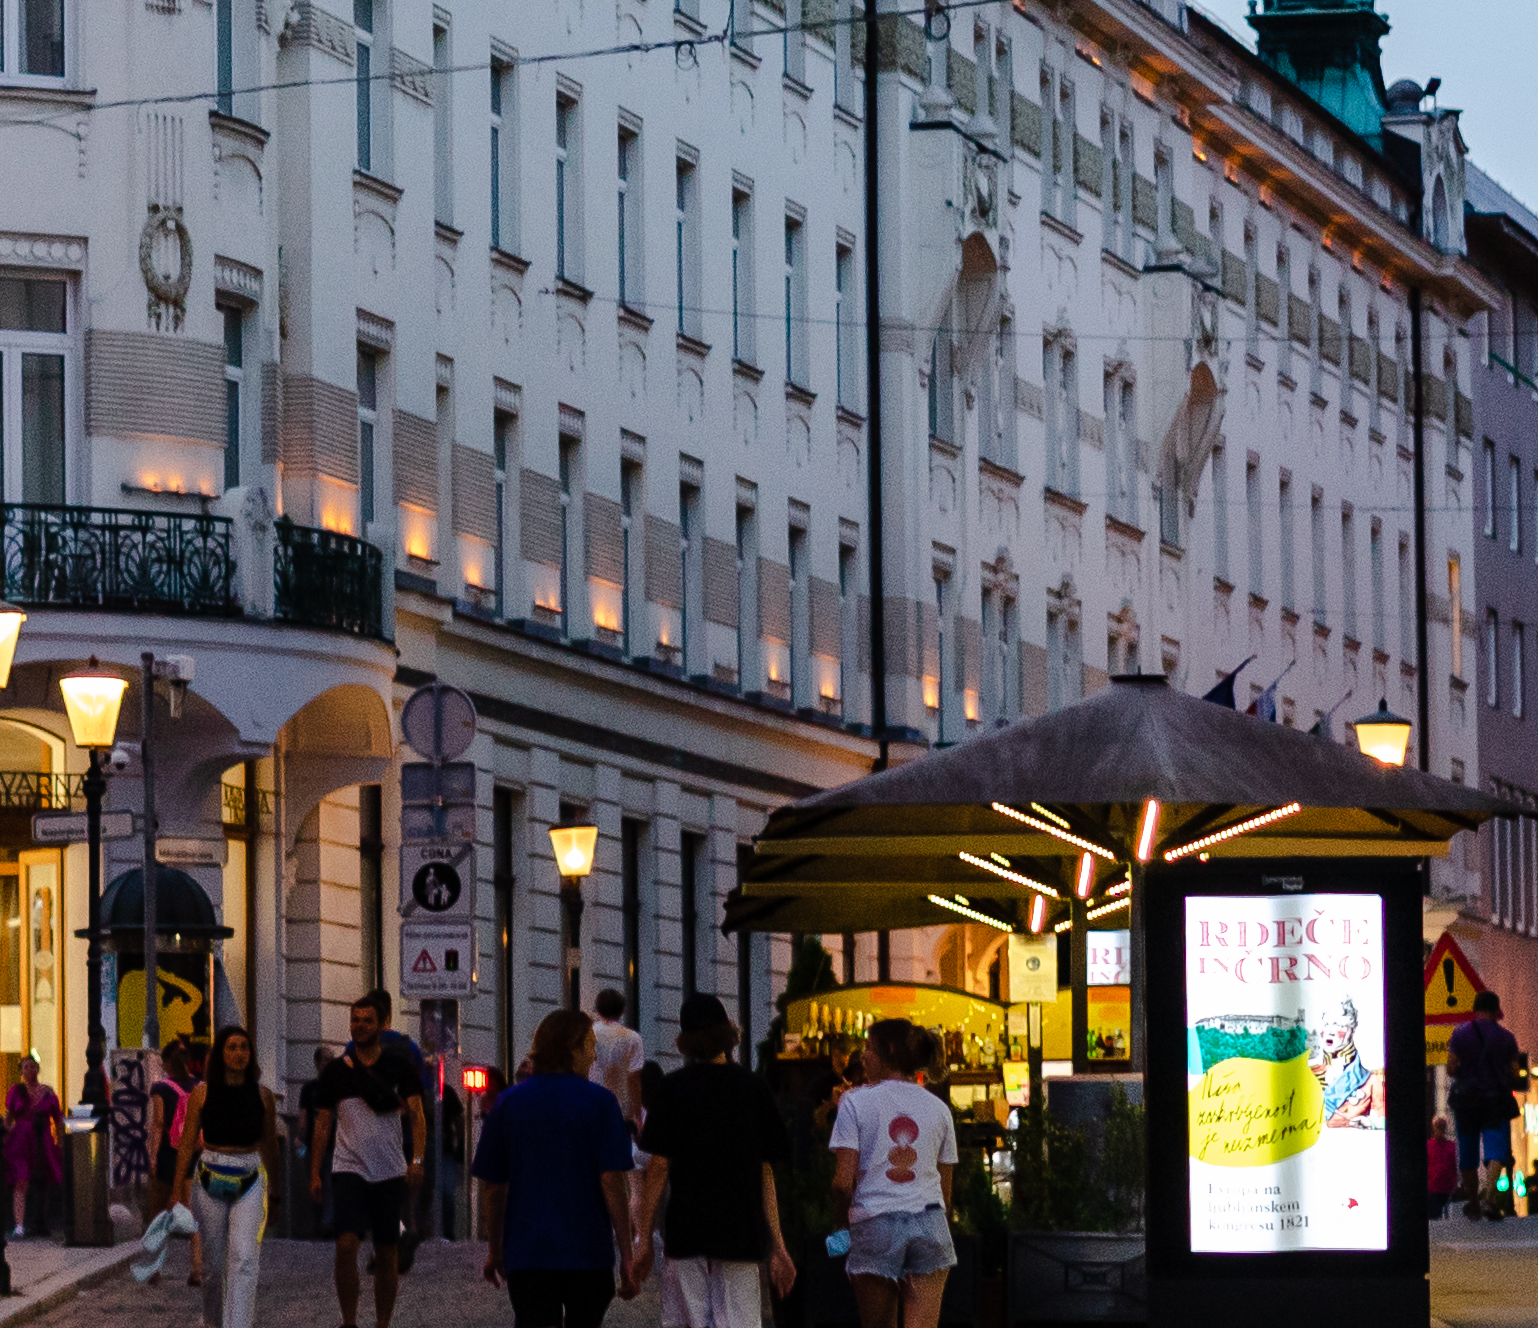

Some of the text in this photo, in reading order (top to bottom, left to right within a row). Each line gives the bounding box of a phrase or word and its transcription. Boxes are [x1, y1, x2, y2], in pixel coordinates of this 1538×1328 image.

[1199, 909, 1369, 948] RDEČE
[1234, 950, 1372, 984] ČRNO
[1198, 1128, 1220, 1161] je
[1264, 1185, 1282, 1195] na
[1279, 1215, 1310, 1231] 1821
